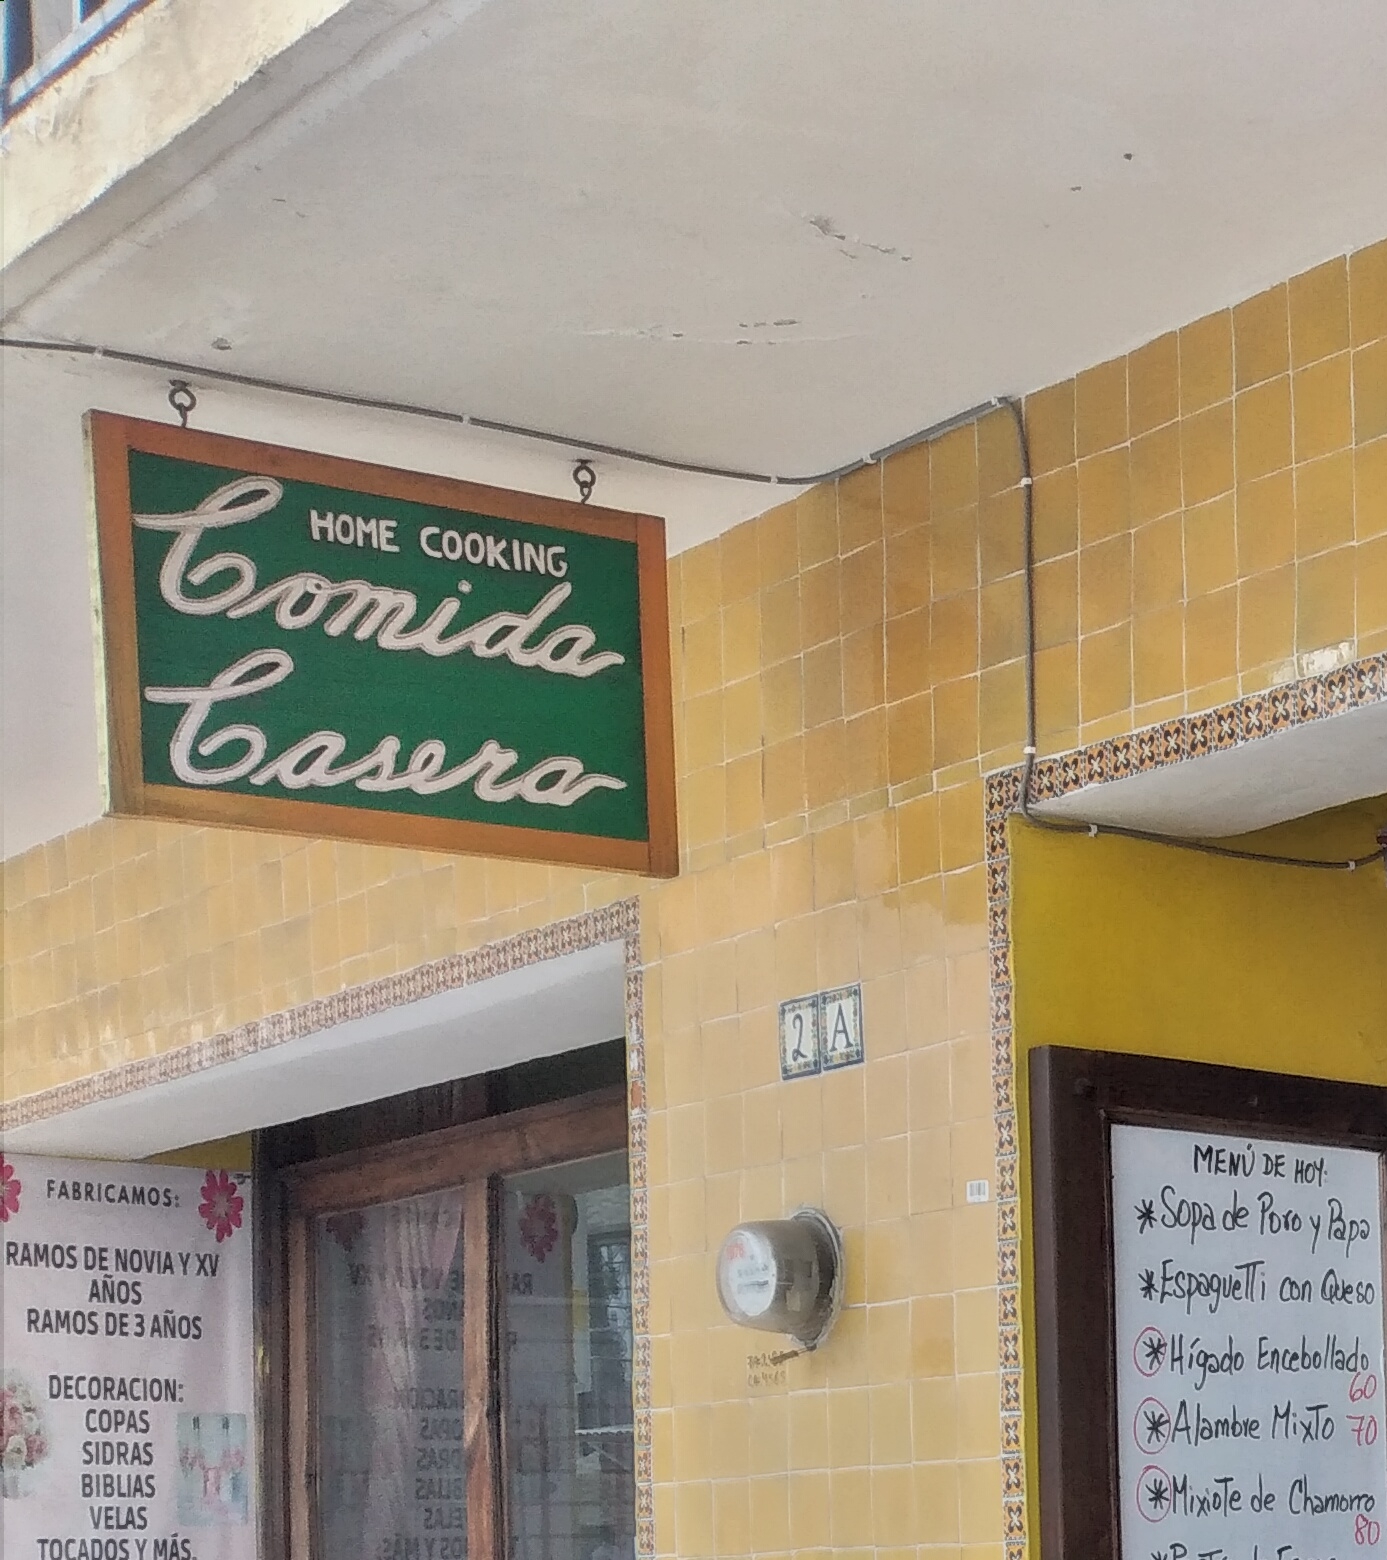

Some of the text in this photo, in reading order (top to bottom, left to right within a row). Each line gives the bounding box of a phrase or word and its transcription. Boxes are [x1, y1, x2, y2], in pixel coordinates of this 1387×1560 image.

[310, 509, 568, 578] HOME COOKING
[132, 475, 625, 677] Comida
[144, 648, 627, 806] Casera
[1193, 1143, 1255, 1178] MENÚ
[1262, 1152, 1286, 1178] DE
[47, 1179, 180, 1208] FABRICAMOS:
[1160, 1185, 1370, 1258] Sopa de Poro y Papa
[5, 1241, 220, 1277] RAMOS DE NOVIA Y XV
[88, 1273, 142, 1305] AÑOS
[1280, 1277, 1312, 1303] con
[1321, 1267, 1375, 1305] Queso
[26, 1308, 202, 1340] RAMOS DE 3 AÑOS
[1170, 1333, 1370, 1391] Hígado Encebollado
[48, 1374, 185, 1403] DECORACION:
[1349, 1371, 1378, 1403] 60
[85, 1408, 150, 1434] COPAS
[1171, 1398, 1260, 1446] Alambre
[1346, 1414, 1378, 1447] 70
[82, 1441, 154, 1466] SIDRAS
[81, 1473, 156, 1499] BIBLIAS
[1250, 1473, 1276, 1513] de
[1288, 1473, 1376, 1515] Chamorro
[89, 1505, 148, 1530] VELAS
[1355, 1513, 1380, 1546] 80
